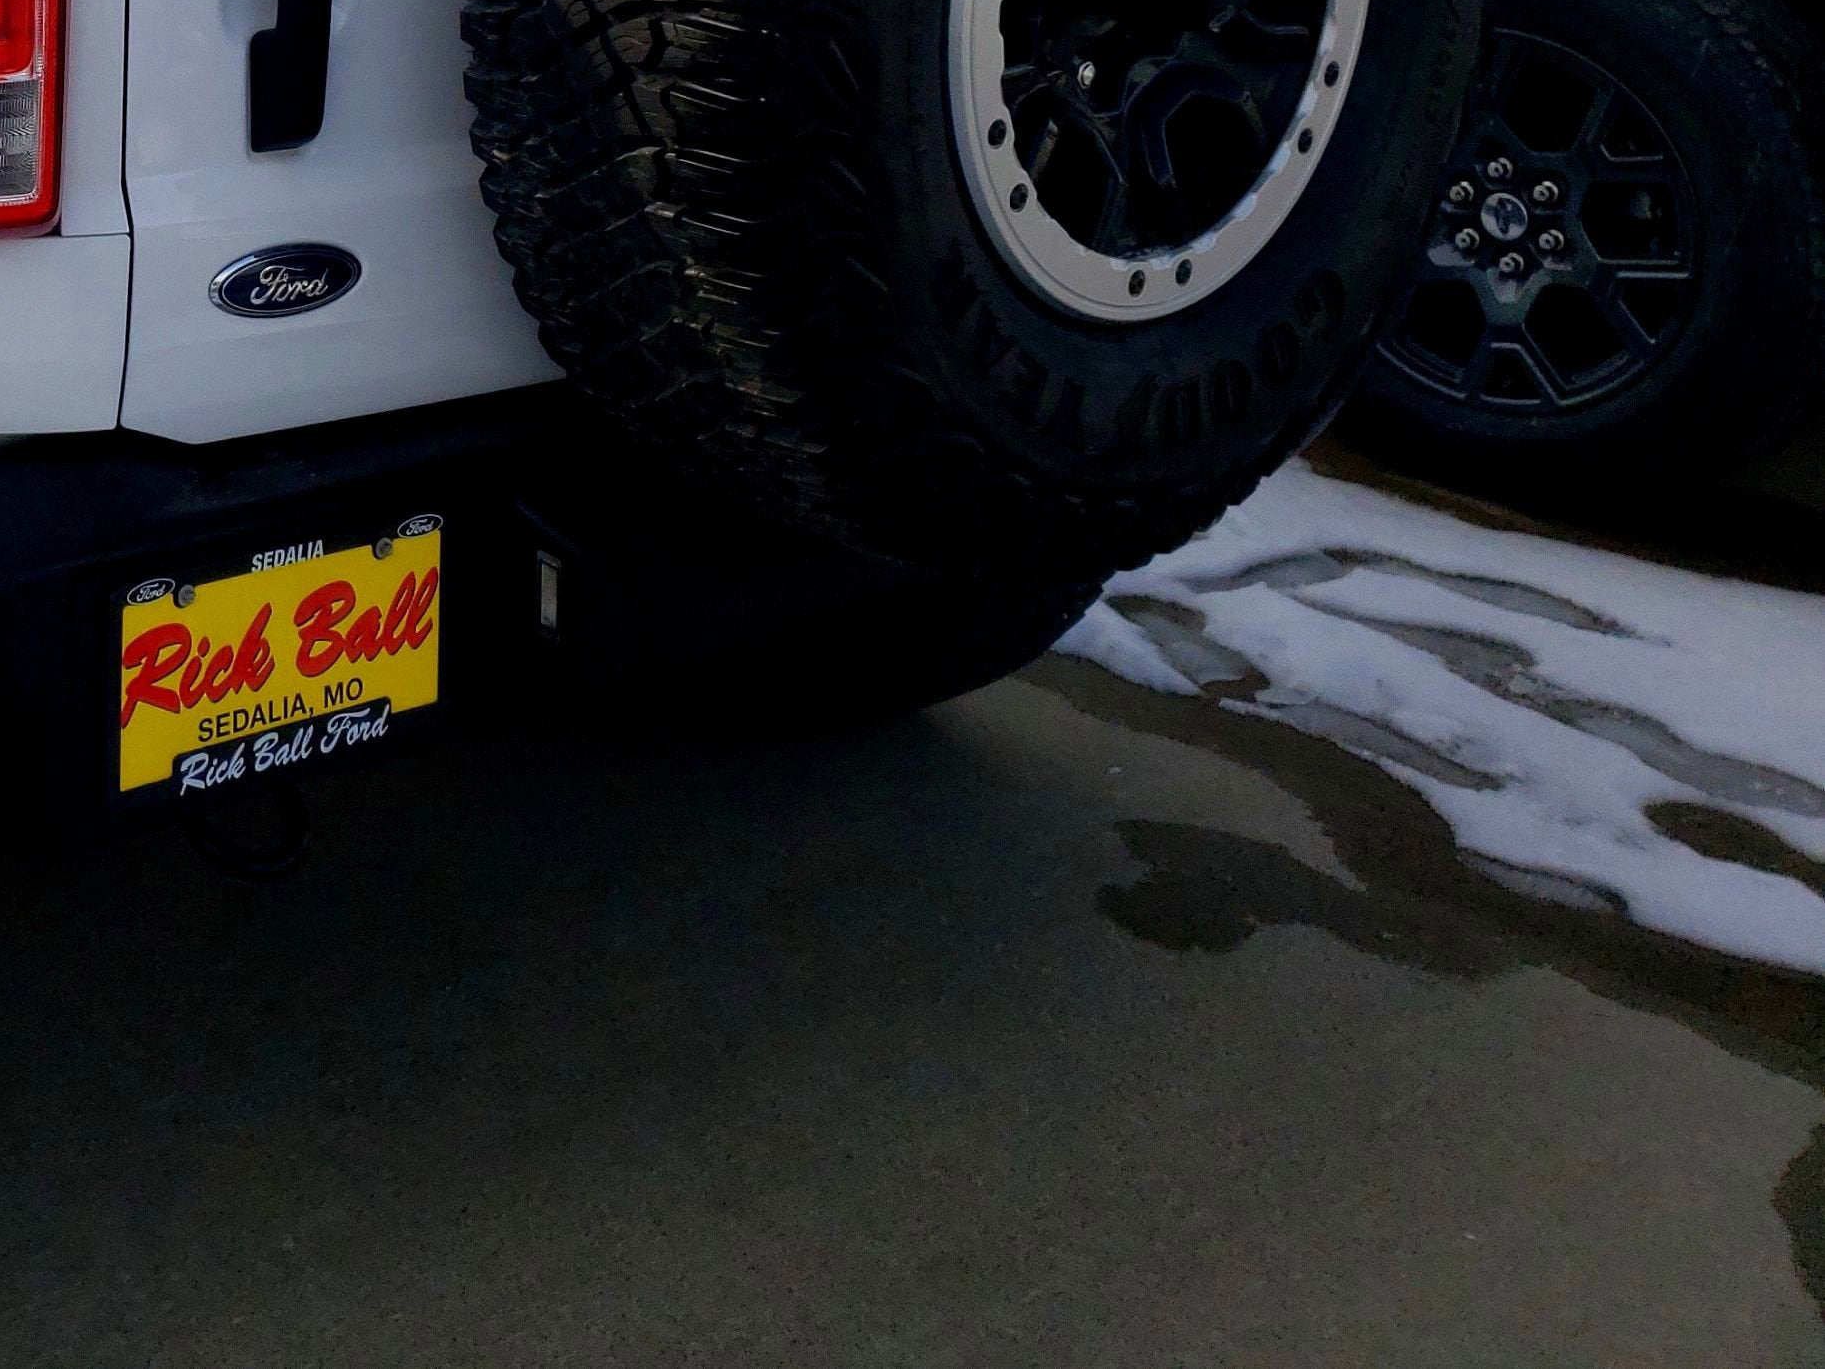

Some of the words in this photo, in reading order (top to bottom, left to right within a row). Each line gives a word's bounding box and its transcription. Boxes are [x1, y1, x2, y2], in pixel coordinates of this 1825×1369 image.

[250, 265, 329, 305] Ford
[251, 539, 325, 573] SEDALIA
[120, 601, 276, 729] Rick
[293, 566, 440, 678] Ball
[197, 692, 314, 742] SEDALIA,
[324, 677, 364, 709] MO
[179, 741, 246, 797] Rick
[252, 724, 314, 773] Ball
[320, 703, 391, 753] Ford
